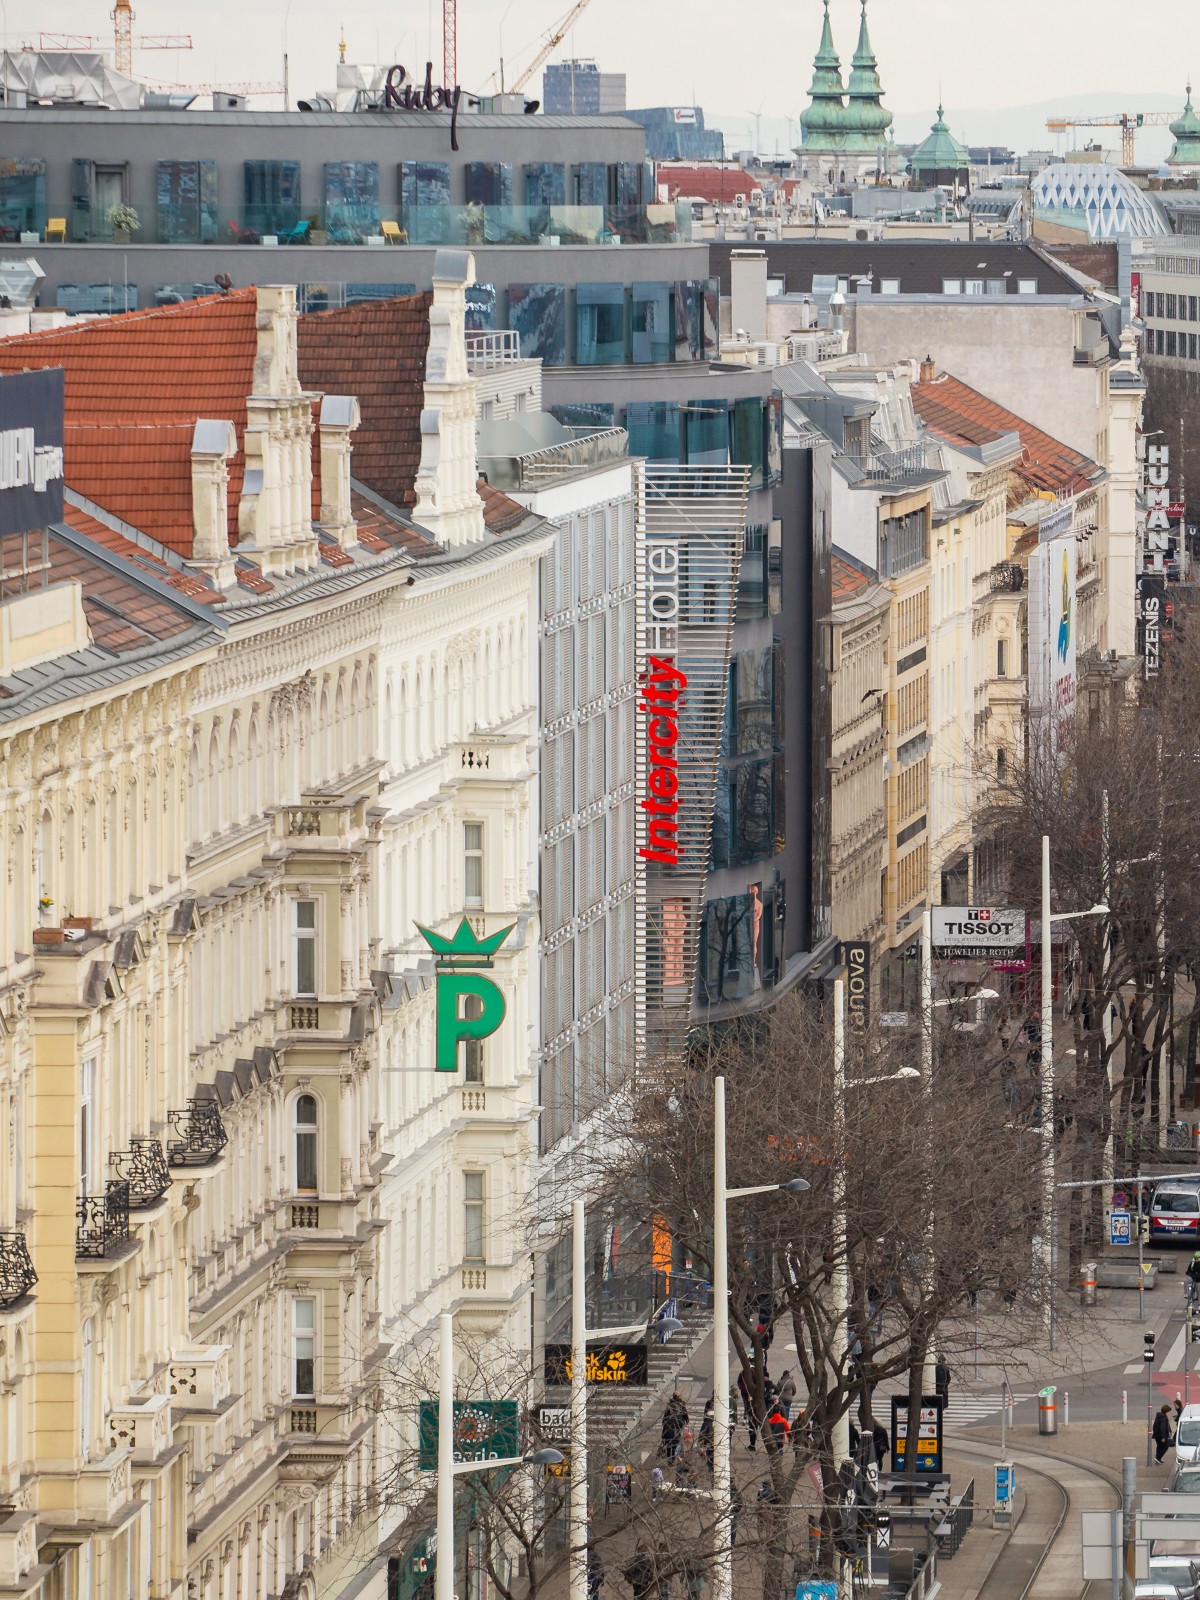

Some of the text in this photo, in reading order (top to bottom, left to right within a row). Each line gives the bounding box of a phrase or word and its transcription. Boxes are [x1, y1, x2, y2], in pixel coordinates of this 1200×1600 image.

[384, 61, 460, 151] Ruby
[1147, 445, 1170, 572] HUMANI
[640, 541, 679, 654] Hotel
[639, 655, 688, 865] Intercity
[944, 922, 1014, 935] TISSOT
[944, 948, 1014, 957] JUWELIER ROTH
[435, 971, 507, 1072] P
[565, 1350, 600, 1368] Jck
[565, 1366, 627, 1382] Wlfskin
